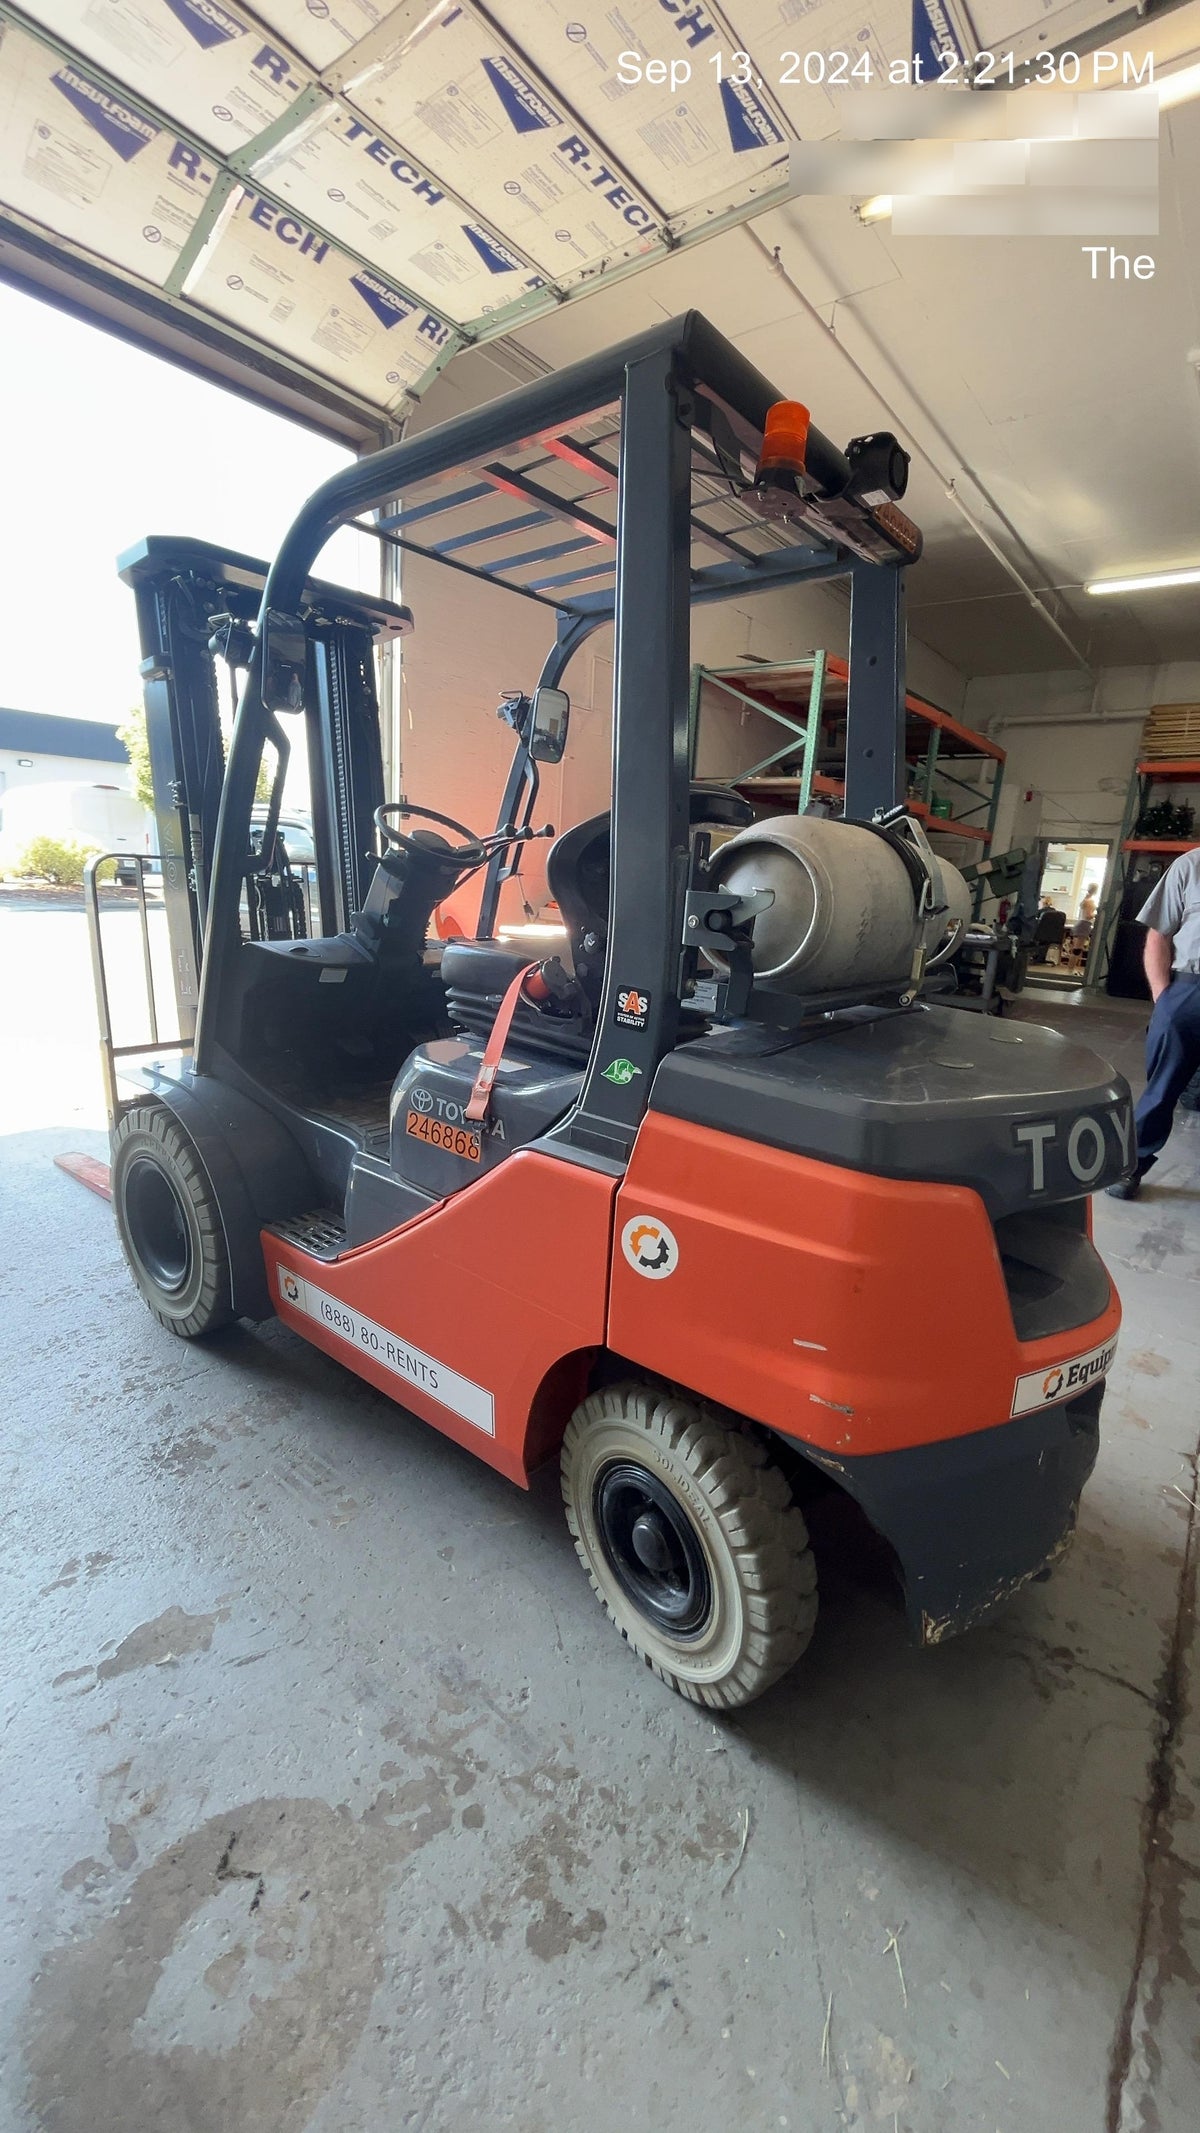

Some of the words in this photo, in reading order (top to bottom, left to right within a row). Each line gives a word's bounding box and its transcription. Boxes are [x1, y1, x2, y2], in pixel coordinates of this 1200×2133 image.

[616, 1015, 646, 1028] STABILITY
[617, 990, 648, 1016] SAS
[407, 1112, 480, 1160] 246868
[436, 1097, 506, 1141] TOYA
[320, 1300, 355, 1338] (888)
[360, 1326, 439, 1389] 80-RENTS
